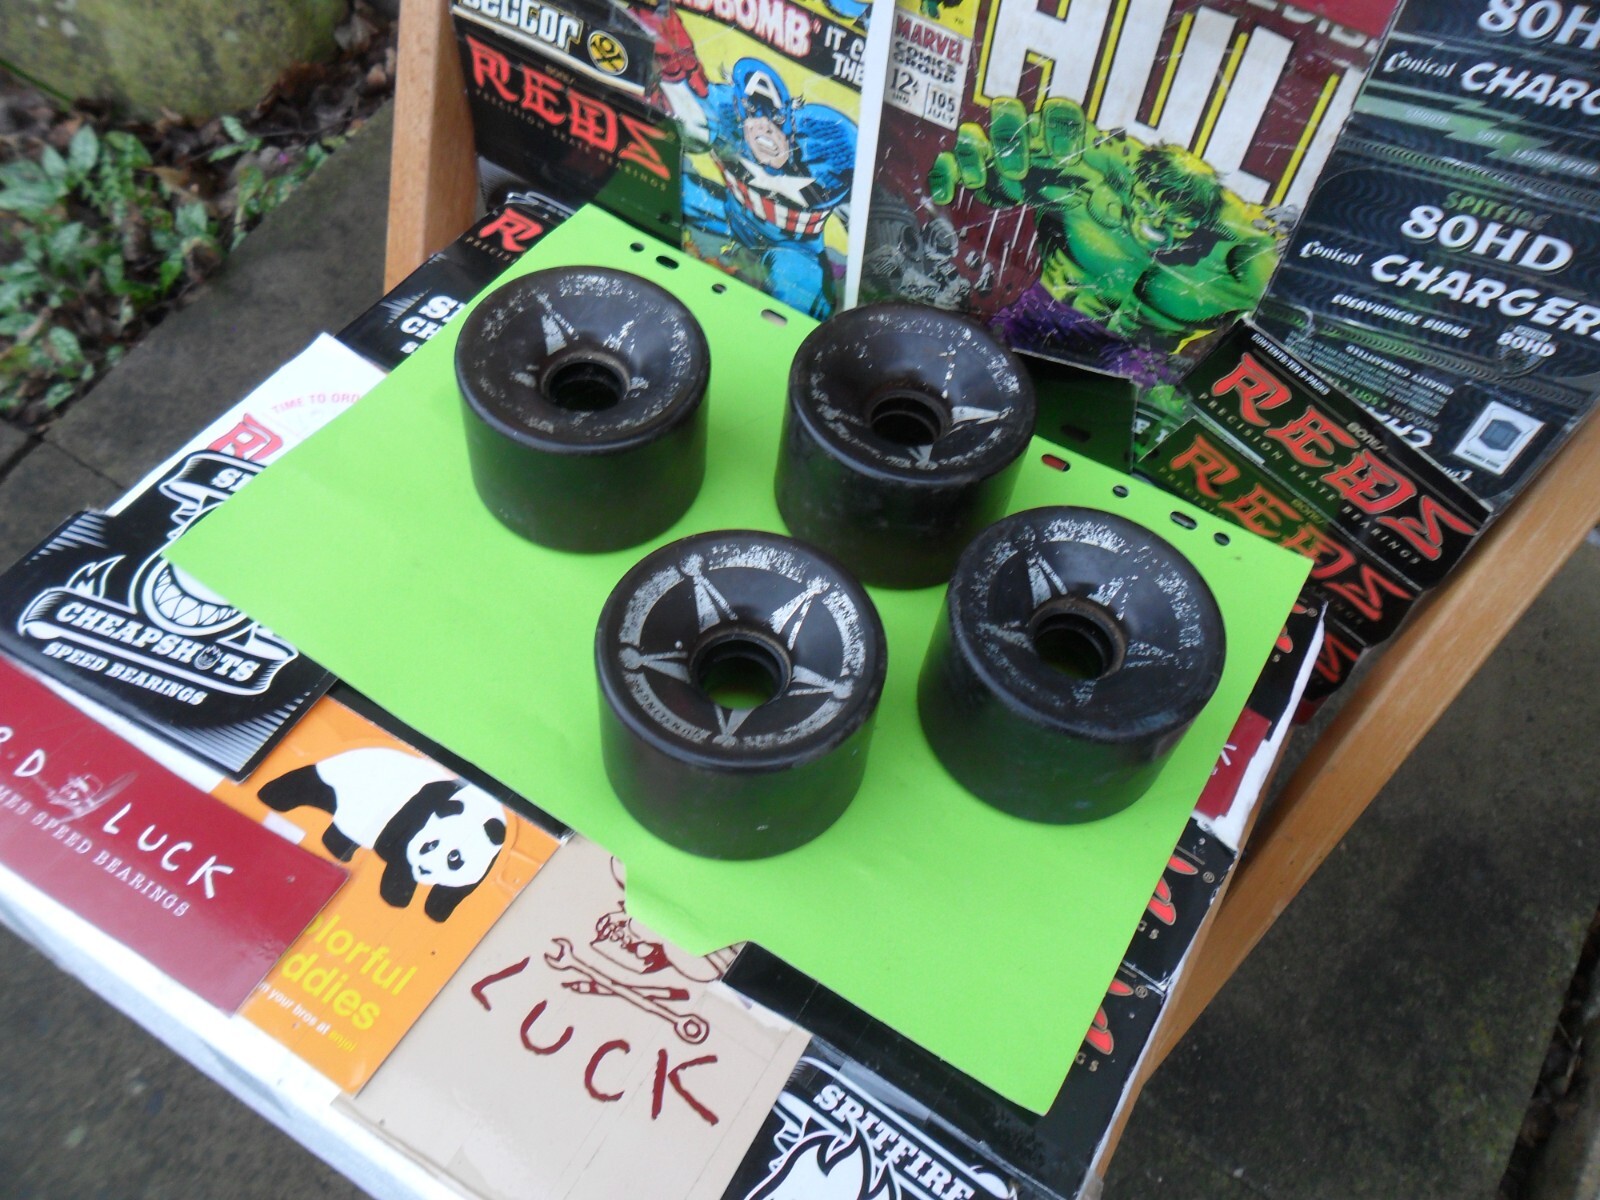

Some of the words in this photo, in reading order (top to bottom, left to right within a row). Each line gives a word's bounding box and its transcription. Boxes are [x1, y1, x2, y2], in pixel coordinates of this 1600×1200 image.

[824, 26, 847, 49] IT
[894, 14, 965, 65] MARVEL
[895, 40, 957, 77] COMICS
[893, 50, 955, 84] GROUP
[1383, 49, 1459, 80] Conical
[466, 35, 670, 181] REDS
[928, 105, 955, 124] JULY
[931, 89, 956, 113] 105
[1443, 190, 1553, 231] SPITFIRE
[1401, 204, 1574, 272] 80HD
[1300, 240, 1364, 266] Conical
[1371, 254, 1600, 342] CHARGER
[1421, 317, 1473, 339] BURNS
[1496, 331, 1557, 359] 80HD
[1198, 392, 1283, 460] PRECISION
[1289, 464, 1337, 502] SKATE
[1341, 505, 1422, 565] BEARINGS
[1211, 351, 1477, 562] REDS
[42, 641, 110, 672] SPEED
[104, 661, 209, 706] BEARINGS
[31, 811, 94, 855] SPEED
[92, 849, 191, 917] BEARINGS
[102, 802, 235, 900] LUCK
[268, 988, 296, 1010] your
[291, 1003, 319, 1027] bros
[470, 955, 719, 1126] LUCK
[813, 1083, 976, 1200] SPITFIRE
